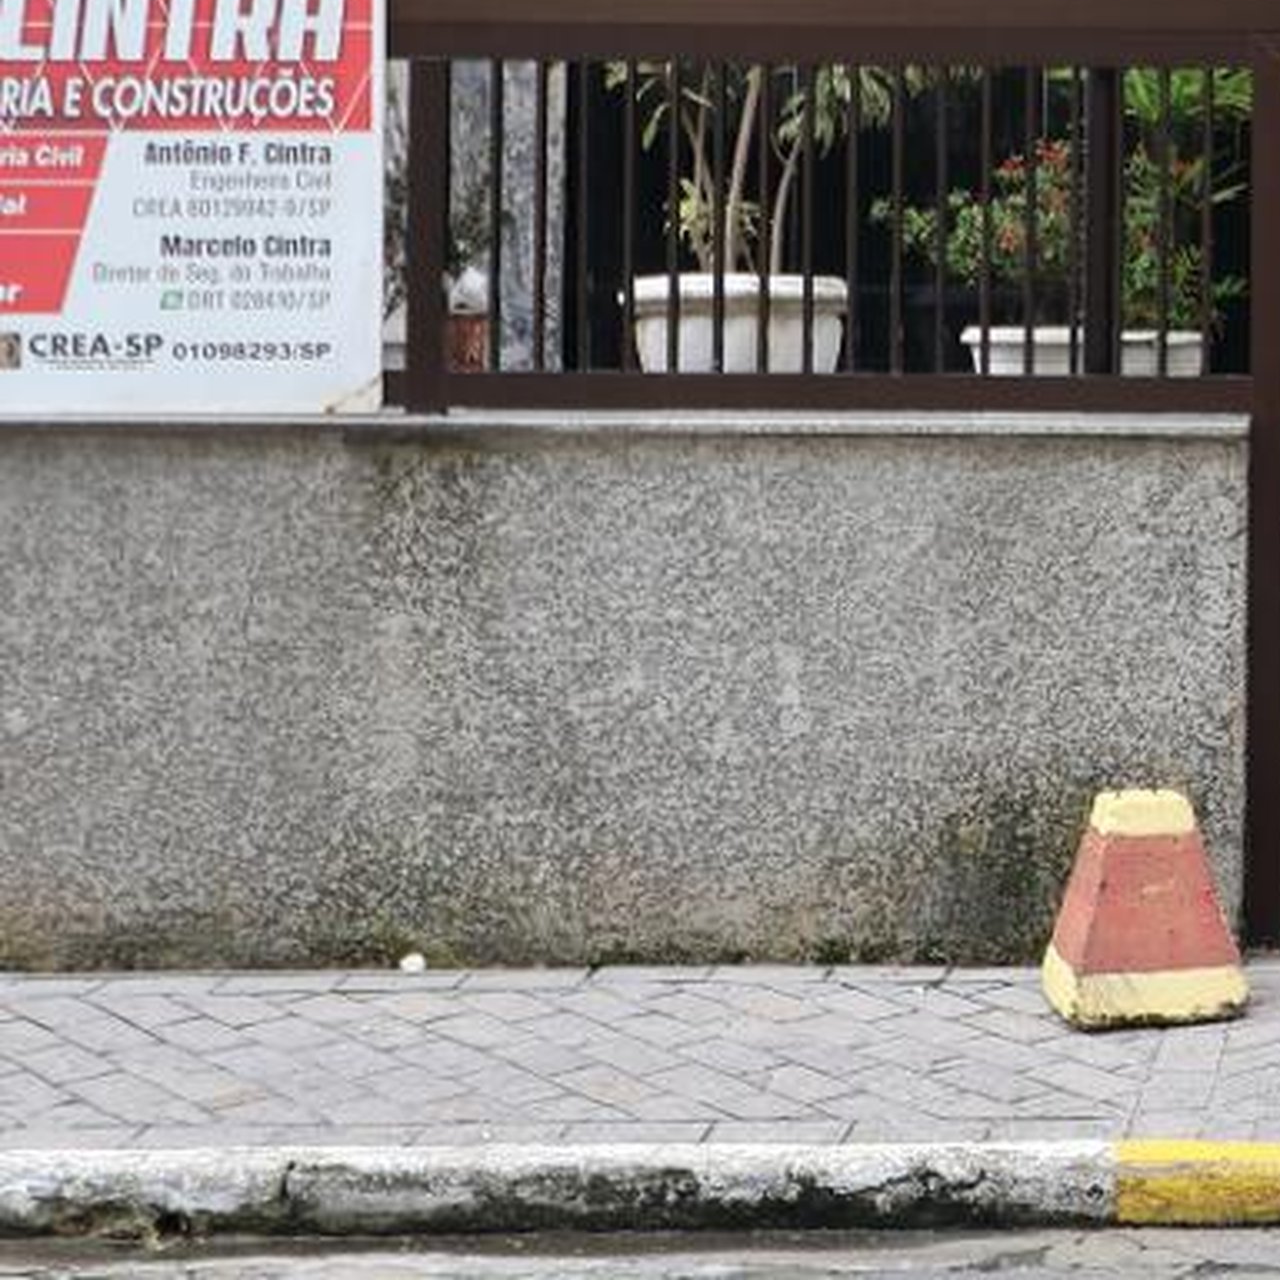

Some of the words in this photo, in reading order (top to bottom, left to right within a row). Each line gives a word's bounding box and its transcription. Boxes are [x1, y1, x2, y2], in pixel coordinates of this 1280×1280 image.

[63, 78, 84, 117] E
[92, 69, 336, 126] CONSTRUÇÕES
[35, 143, 84, 167] Civil
[144, 140, 232, 165] Antônio
[263, 142, 332, 165] Cintra
[160, 235, 257, 258] Marcelo
[263, 235, 332, 258] Cintra
[28, 333, 164, 358] CREA-SP
